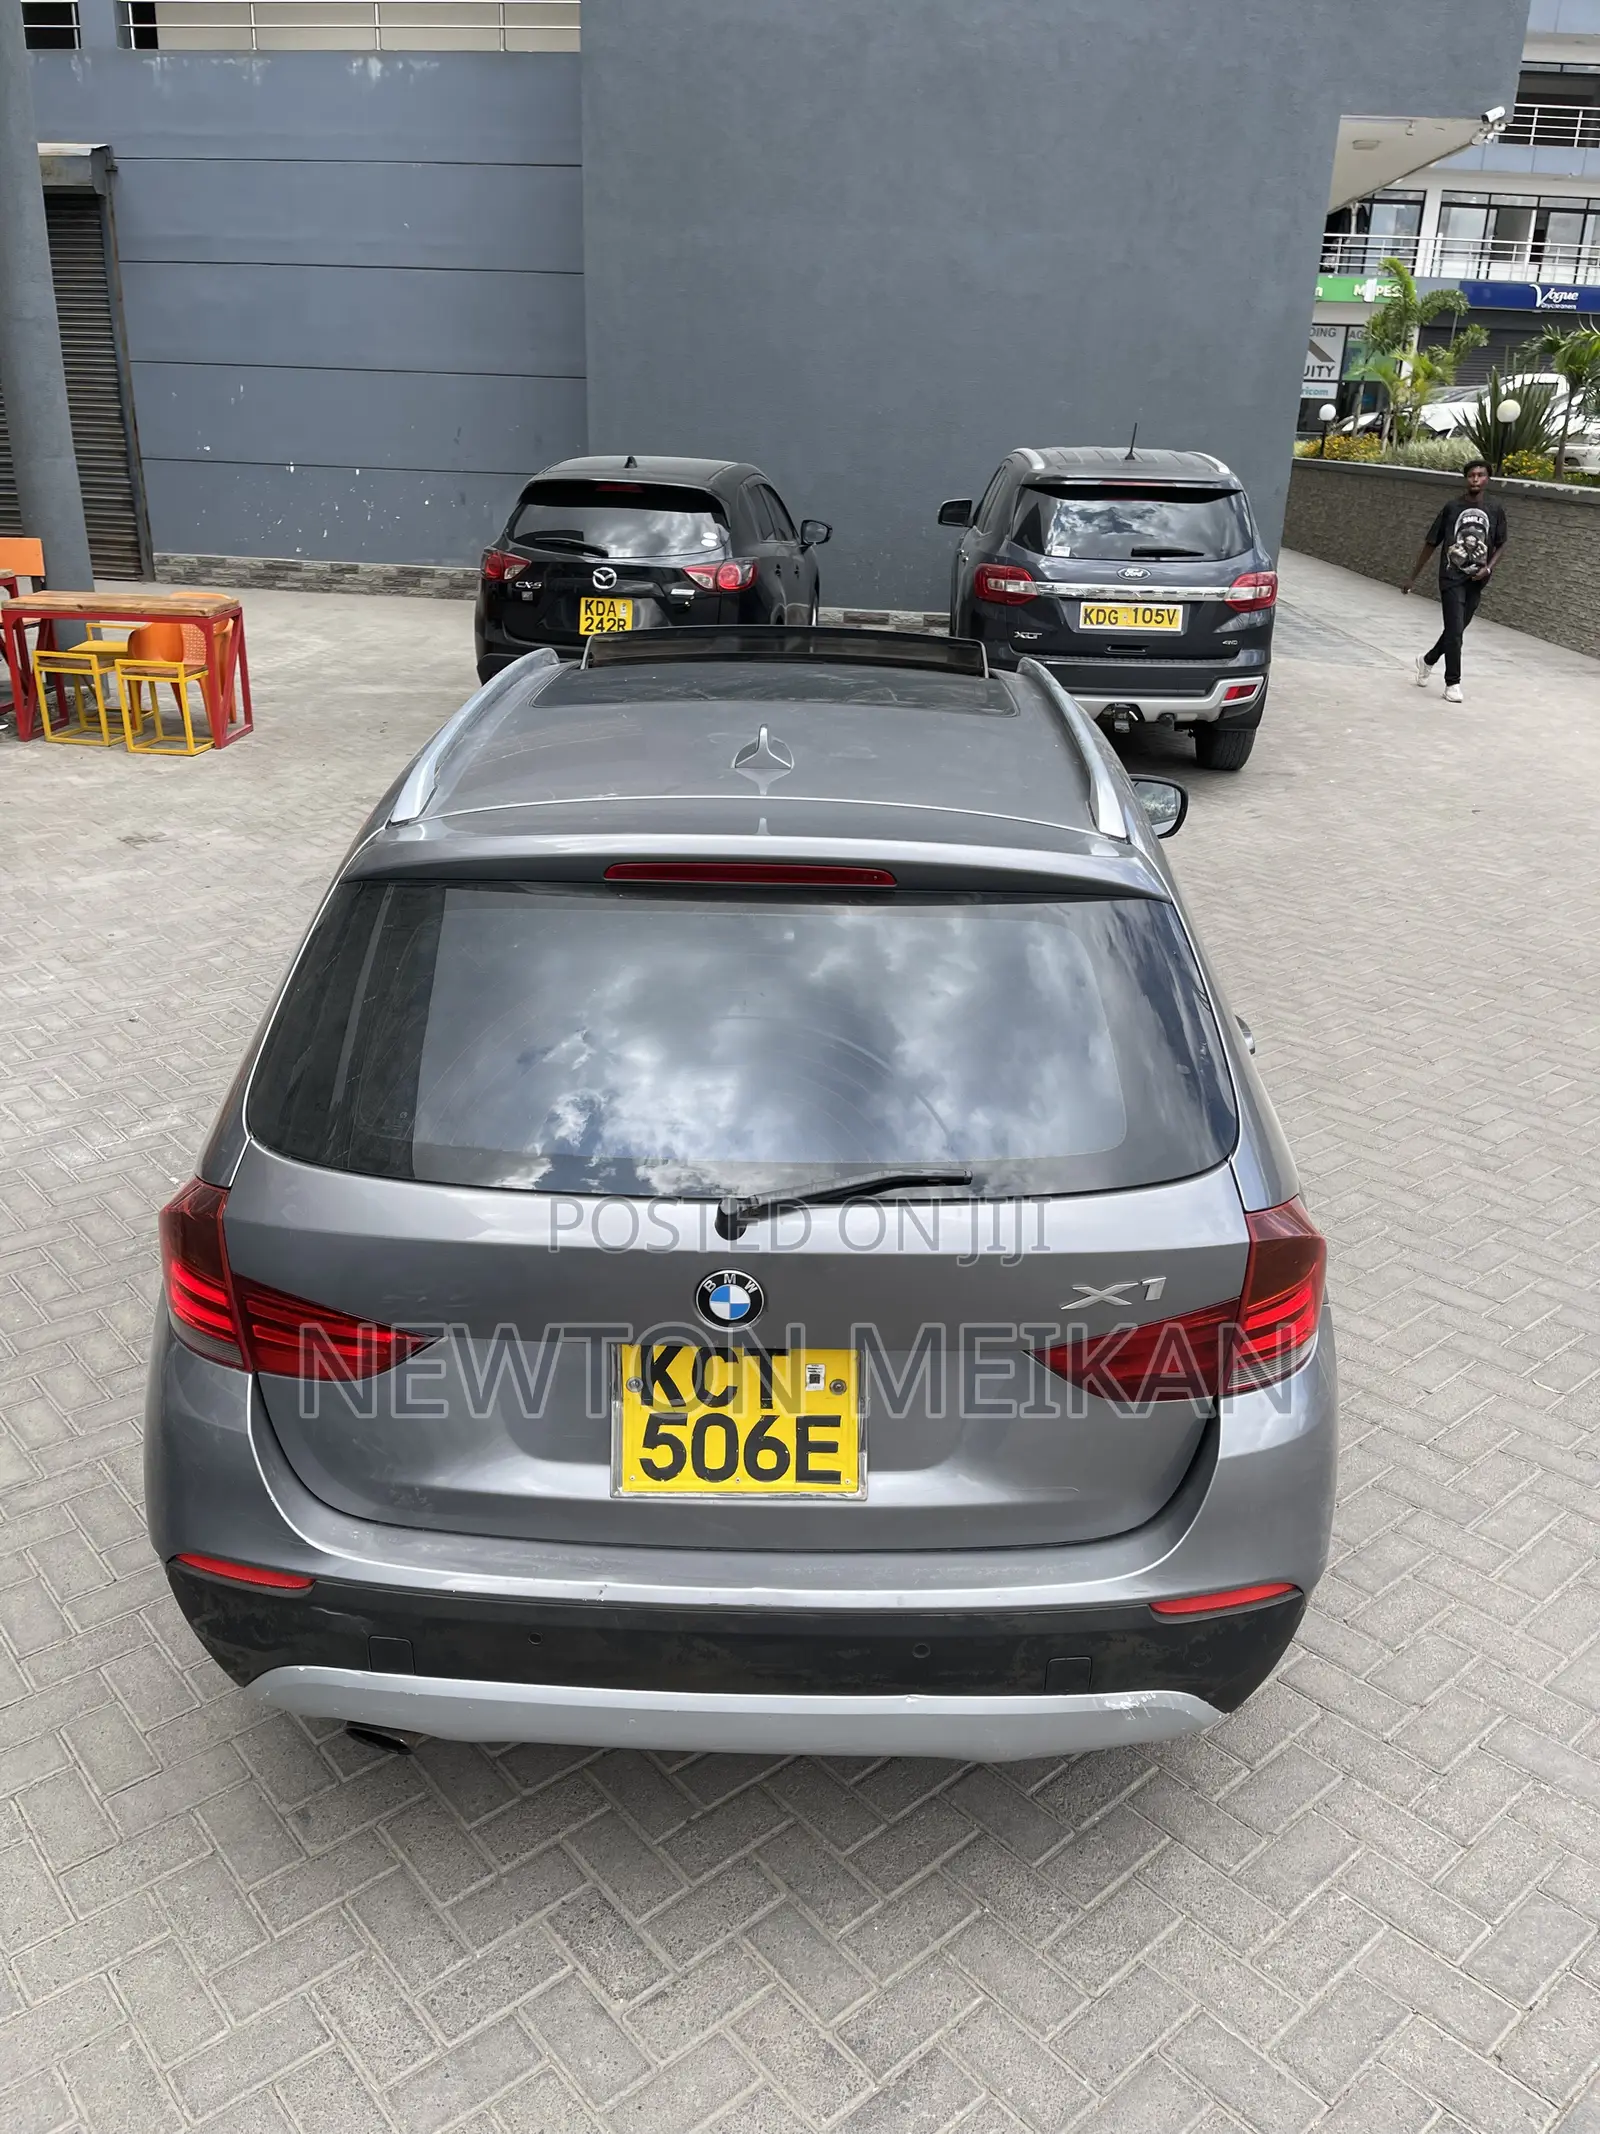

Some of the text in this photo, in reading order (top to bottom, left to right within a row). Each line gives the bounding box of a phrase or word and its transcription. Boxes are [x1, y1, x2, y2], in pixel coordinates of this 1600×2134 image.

[1529, 284, 1579, 308] Vogue
[1124, 568, 1144, 577] Ford
[515, 581, 542, 590] CX-5
[585, 600, 617, 618] KDA
[1083, 607, 1178, 626] KDG 105V
[584, 617, 627, 632] 242R
[704, 1273, 758, 1294] BMW
[1060, 1276, 1167, 1310] X1
[640, 1345, 791, 1410] KCT
[639, 1412, 842, 1485] 506E
